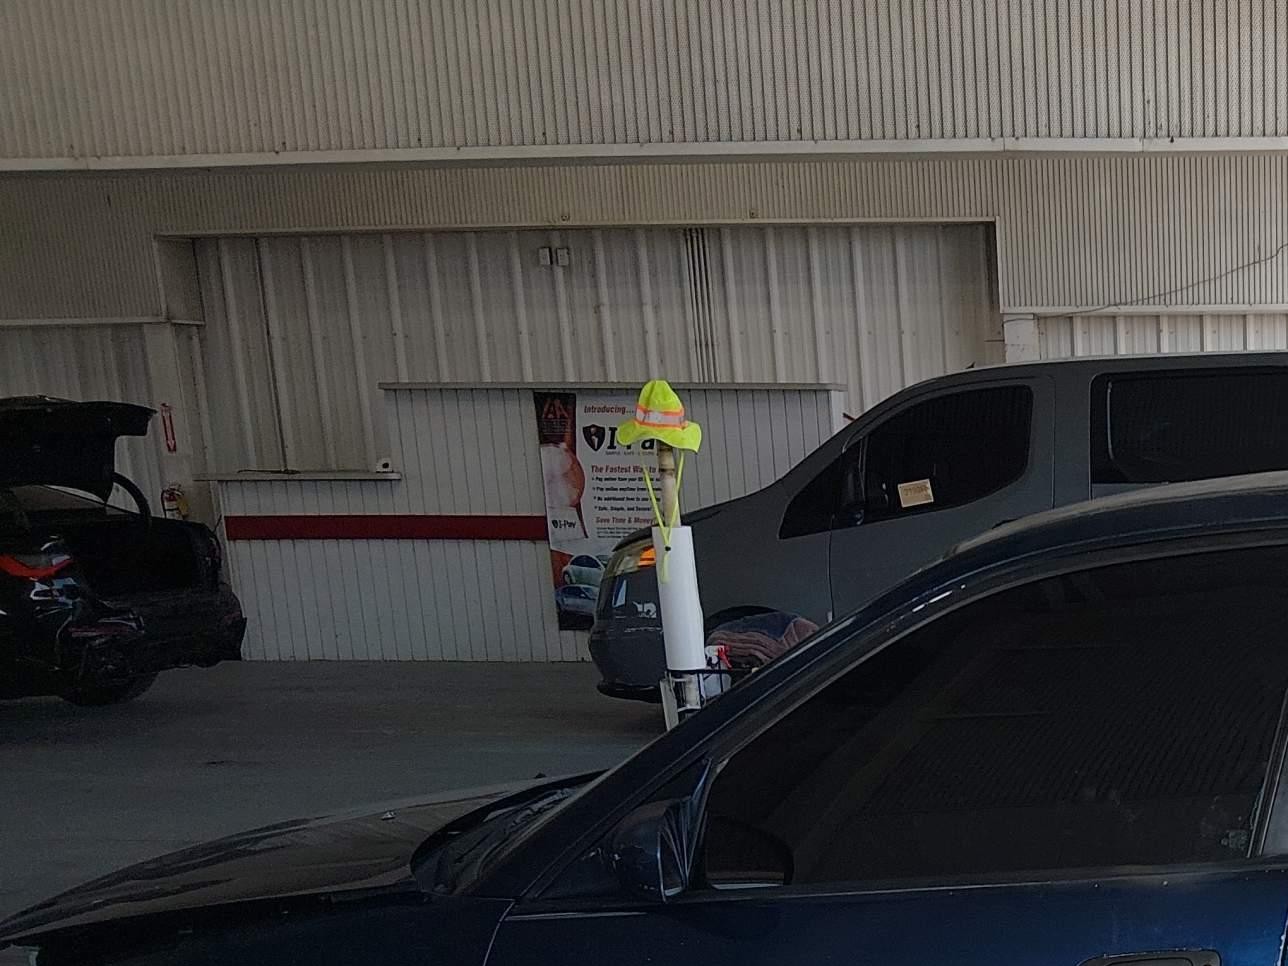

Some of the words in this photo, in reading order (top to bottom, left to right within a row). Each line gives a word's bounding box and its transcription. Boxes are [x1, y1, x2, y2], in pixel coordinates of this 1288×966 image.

[584, 405, 634, 415] Introducing...
[592, 465, 604, 473] The
[605, 465, 631, 473] Fastest
